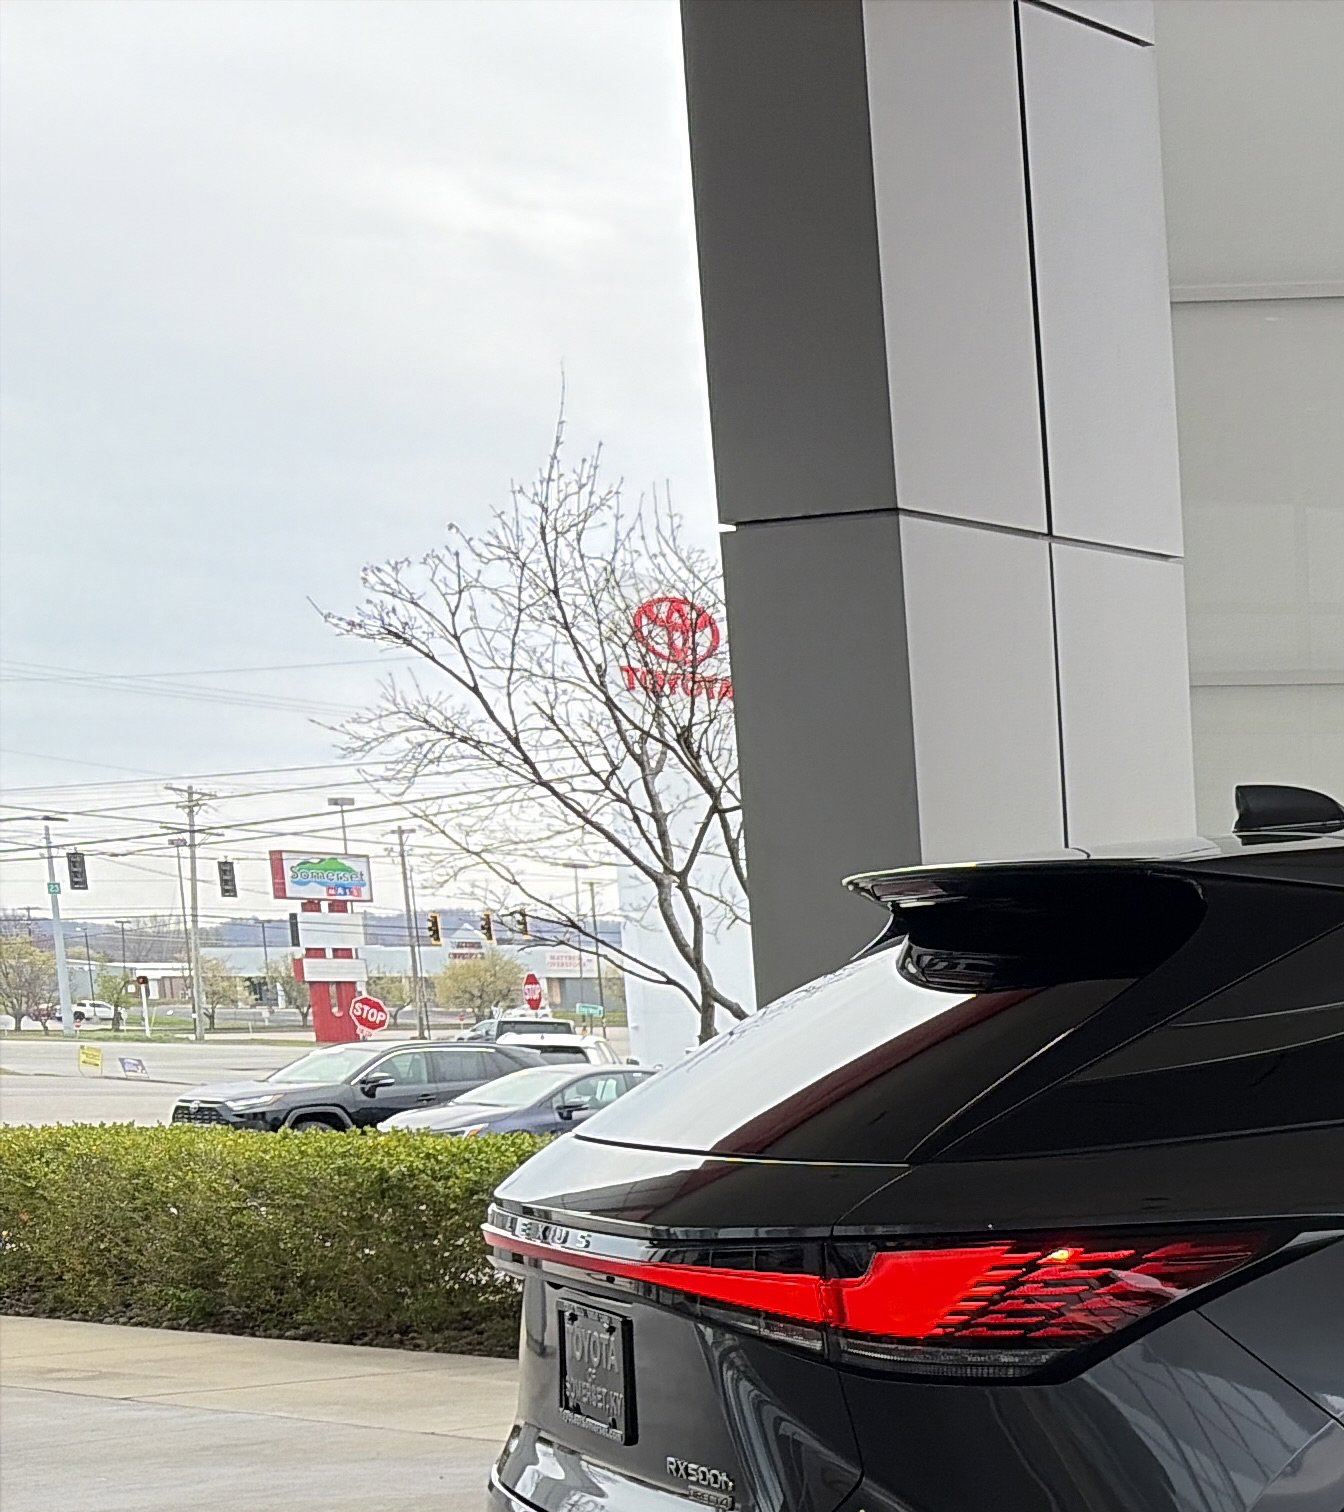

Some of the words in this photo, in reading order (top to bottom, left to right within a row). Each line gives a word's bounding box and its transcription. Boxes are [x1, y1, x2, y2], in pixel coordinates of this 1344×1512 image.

[620, 665, 735, 700] TOYOTA
[290, 865, 365, 882] Somerset
[524, 984, 541, 1000] STOP
[353, 1002, 387, 1025] STOP
[506, 1217, 592, 1248] LEXUS
[565, 1325, 619, 1373] TOYOTA
